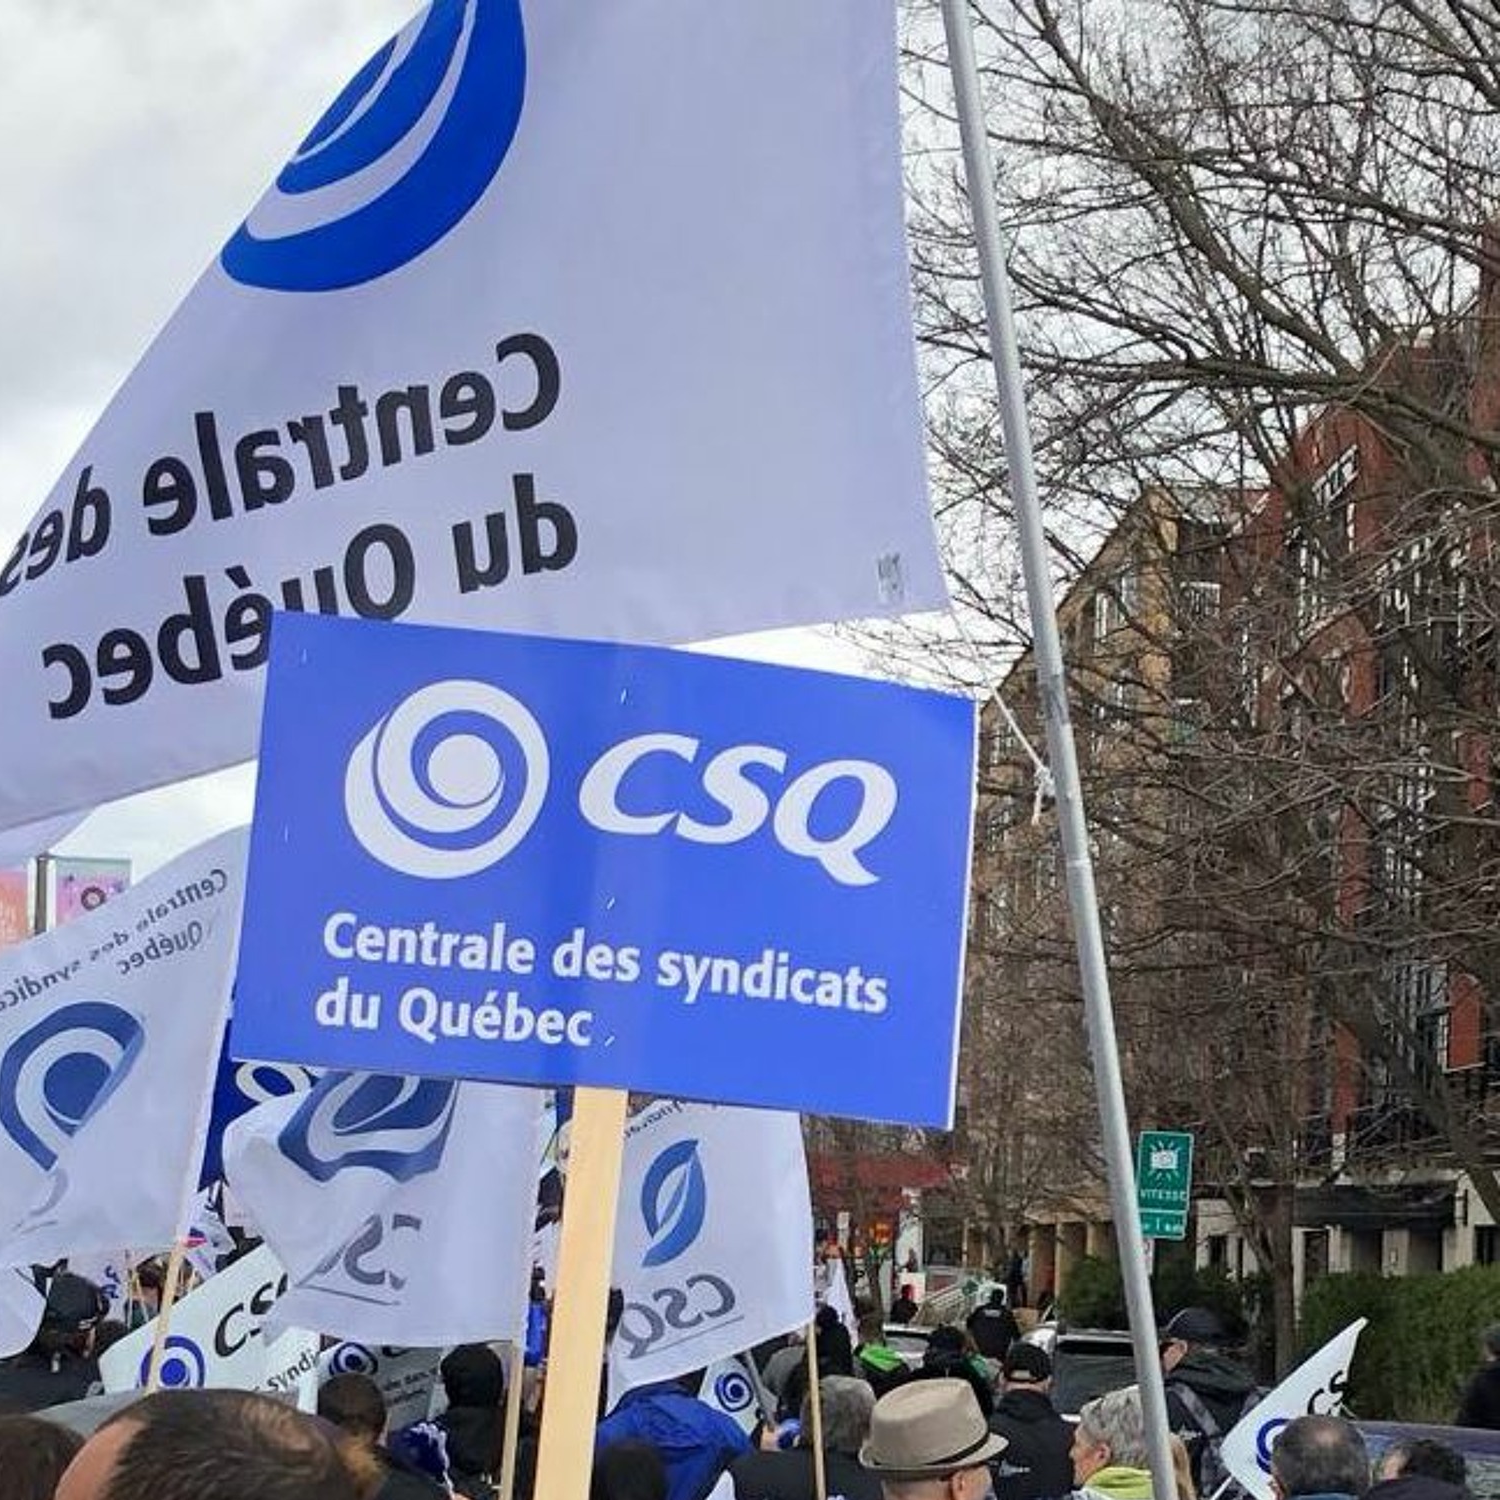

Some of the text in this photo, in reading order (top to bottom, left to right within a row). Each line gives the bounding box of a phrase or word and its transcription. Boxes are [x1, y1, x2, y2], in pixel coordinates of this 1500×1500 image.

[577, 732, 899, 888] CSQ
[314, 977, 594, 1049] du Québec
[322, 911, 890, 1016] Centrale des syndicats
